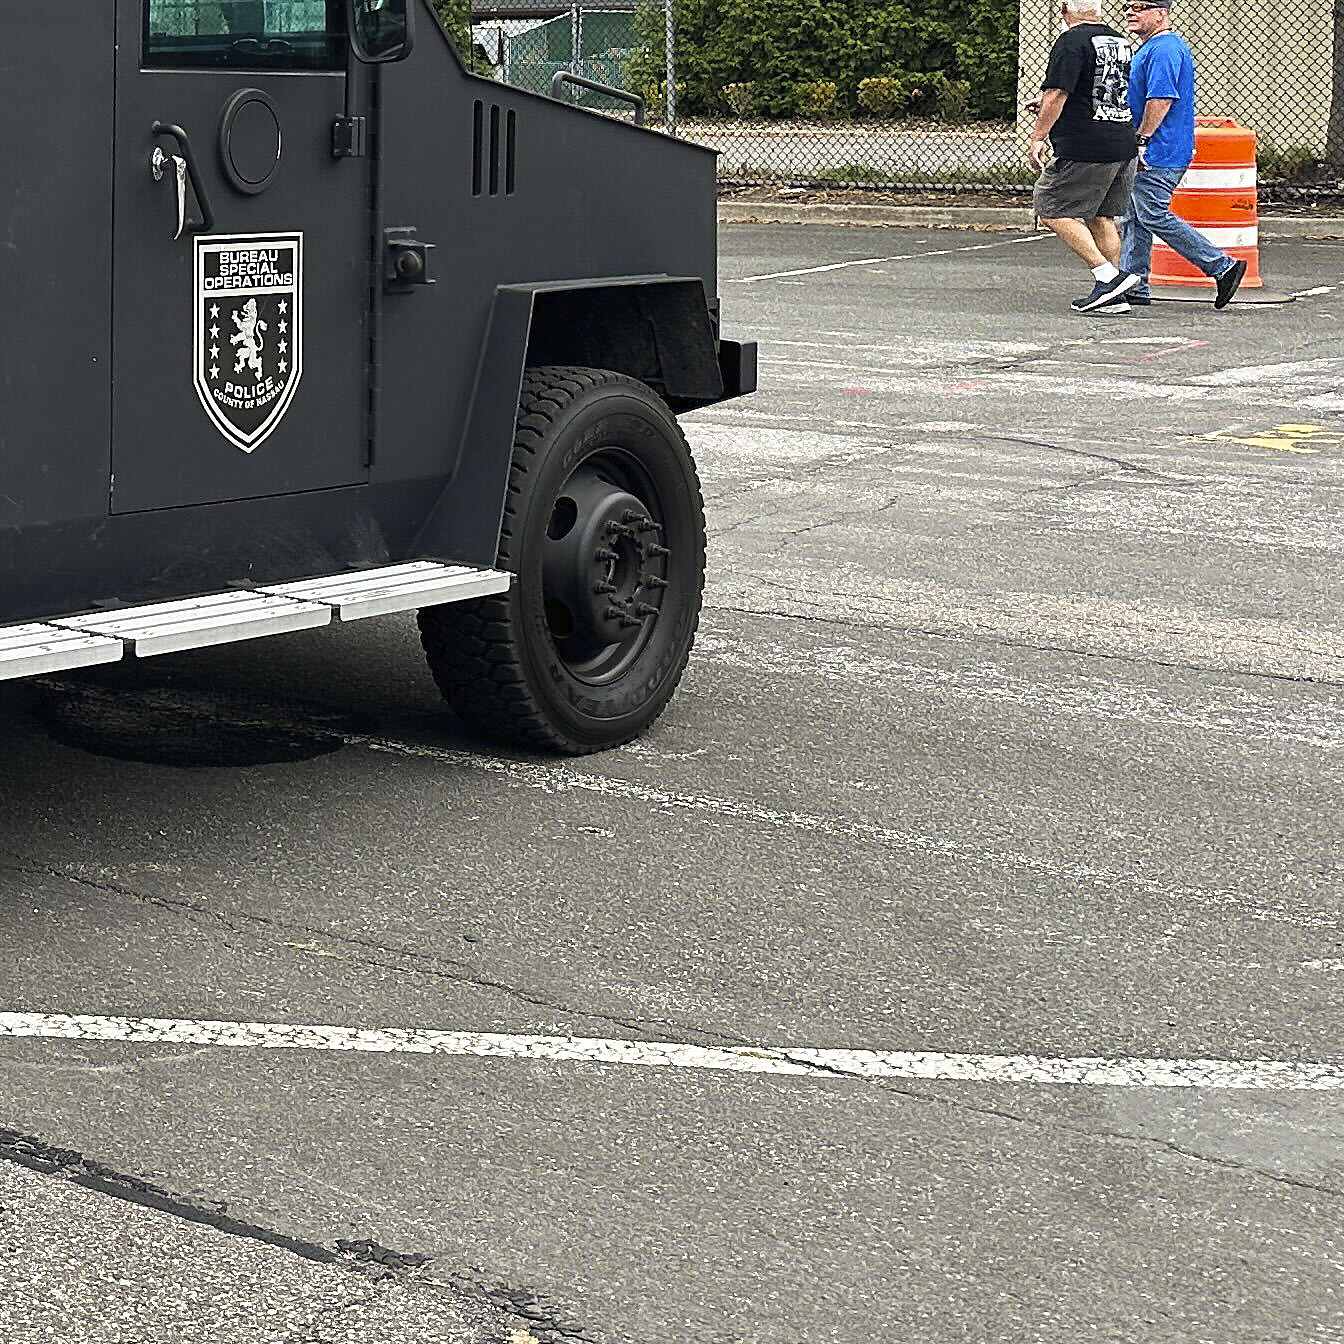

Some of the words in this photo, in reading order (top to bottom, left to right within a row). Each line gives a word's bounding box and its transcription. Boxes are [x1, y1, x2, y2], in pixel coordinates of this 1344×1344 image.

[219, 249, 279, 264] BUREAU
[219, 262, 279, 276] SPECIAL
[204, 272, 293, 290] OPERATIONS
[213, 388, 244, 409] COUNTY
[244, 400, 255, 409] OF
[256, 379, 285, 407] NASSAU
[224, 375, 274, 399] POLICE
